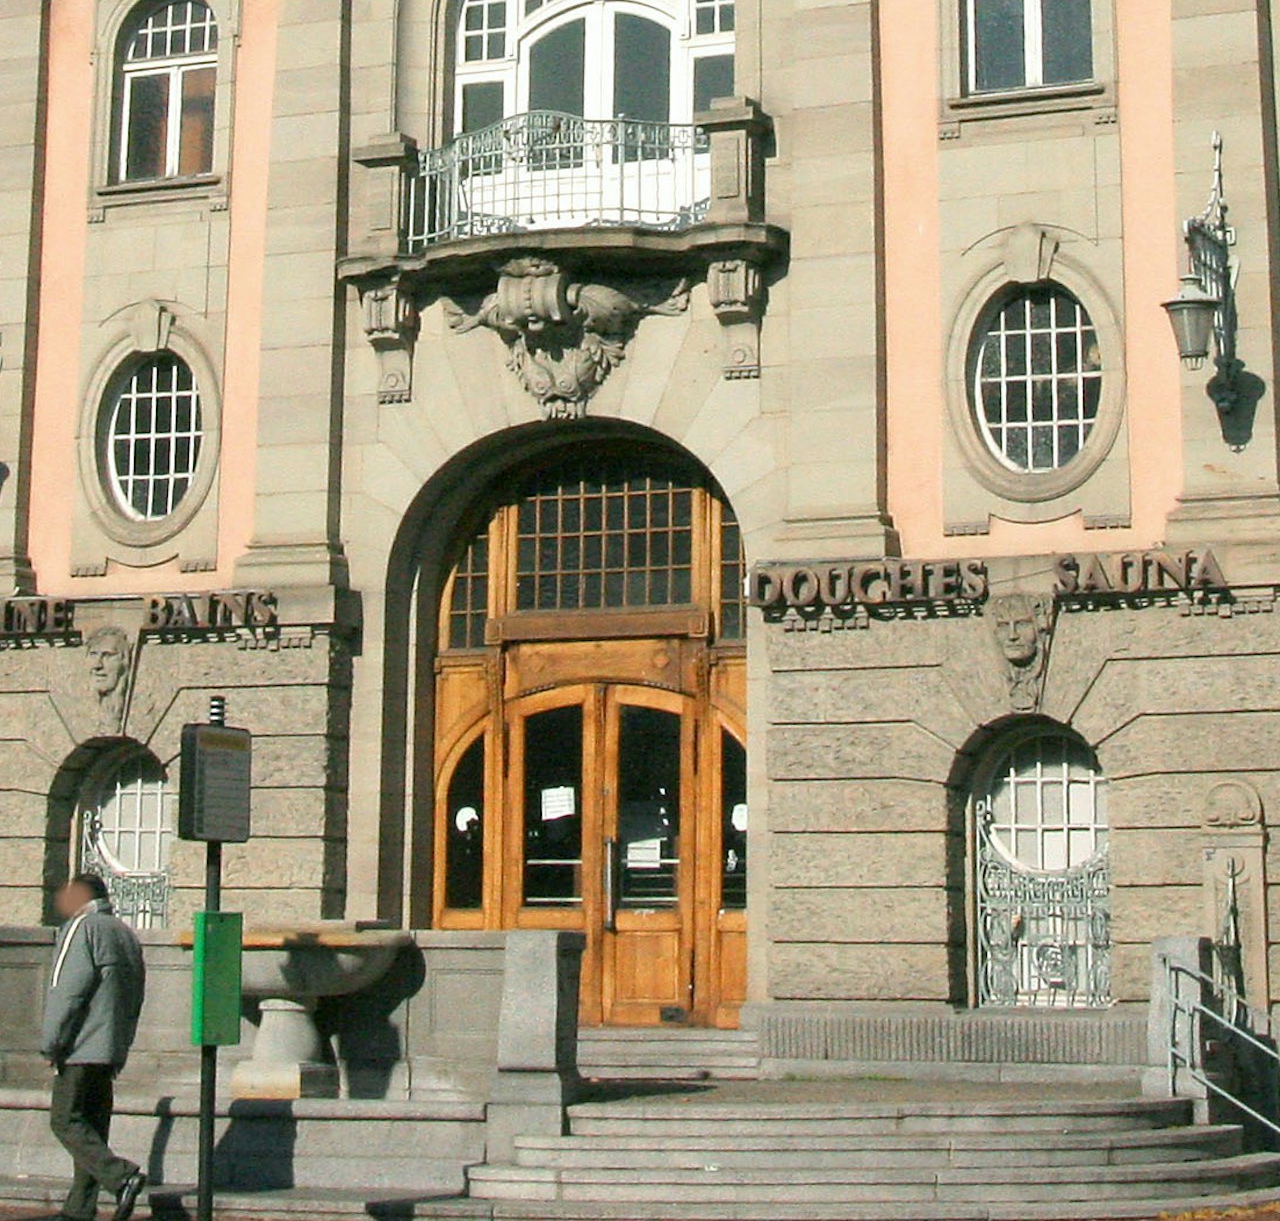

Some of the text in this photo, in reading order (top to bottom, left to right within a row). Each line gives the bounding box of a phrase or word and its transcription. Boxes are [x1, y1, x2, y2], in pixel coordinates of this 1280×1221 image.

[748, 545, 1228, 605] DOUCHES SAUNA
[144, 590, 276, 628] BAINS
